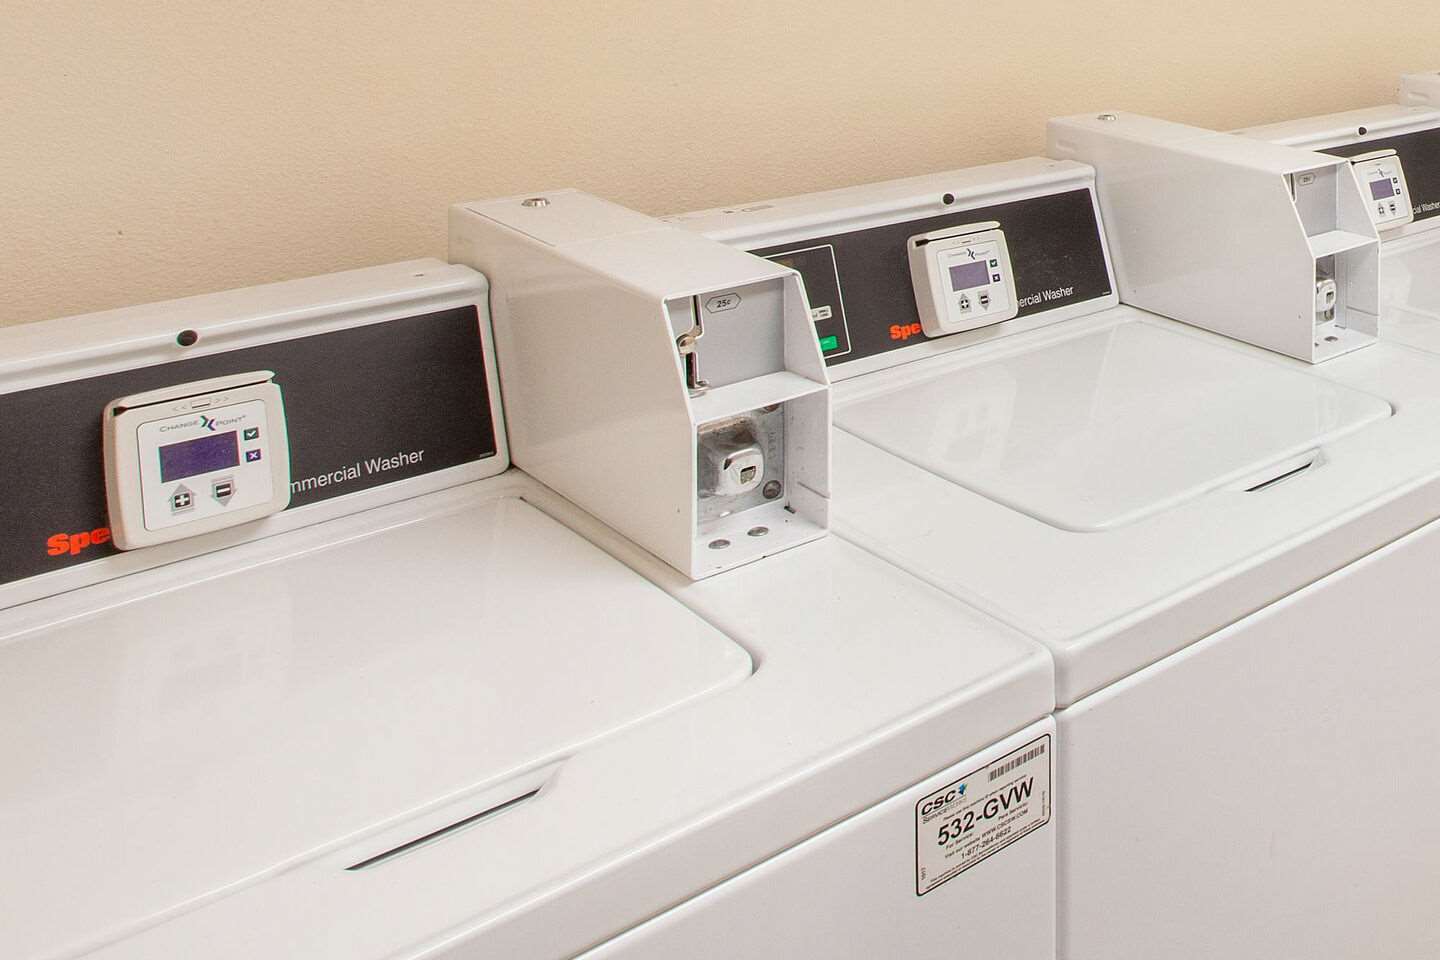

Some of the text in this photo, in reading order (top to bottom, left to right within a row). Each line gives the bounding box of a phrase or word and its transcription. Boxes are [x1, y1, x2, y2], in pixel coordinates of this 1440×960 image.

[1042, 286, 1075, 302] Washer
[889, 322, 922, 341] Spe
[289, 449, 425, 494] mmercial Washer
[47, 527, 111, 557] Spe
[921, 790, 957, 816] CSC
[937, 776, 1034, 846] 532-GVW
